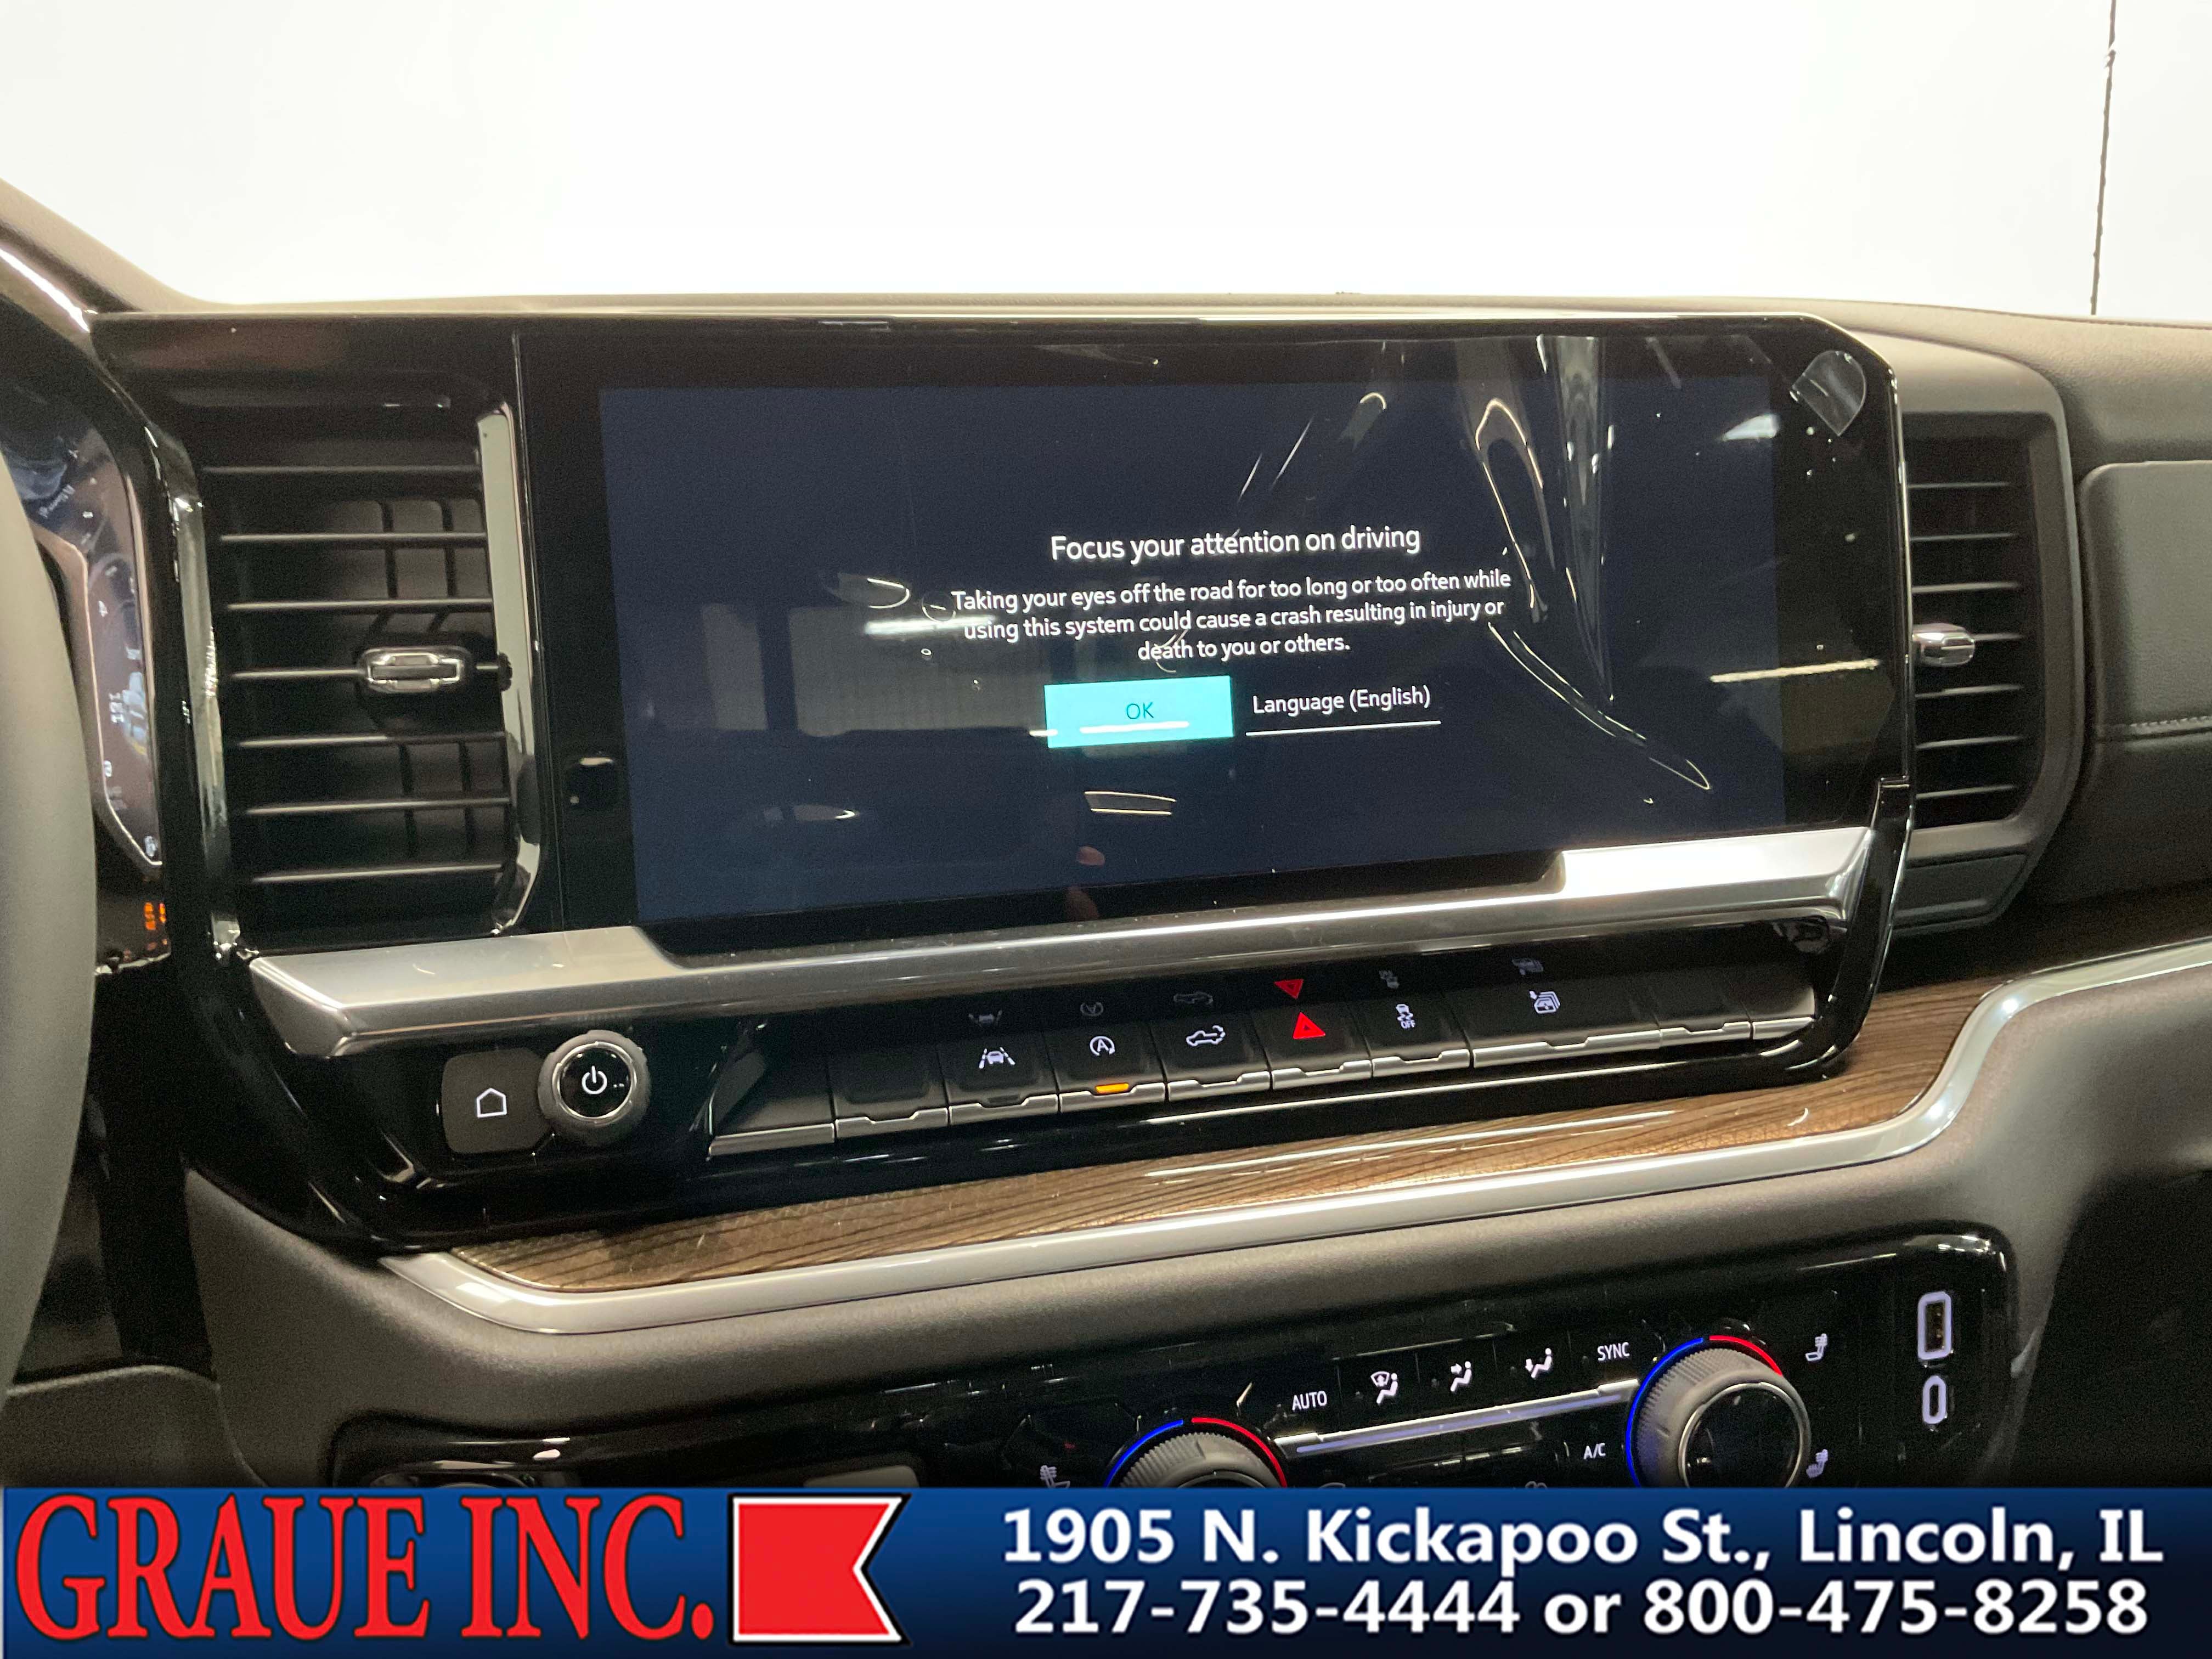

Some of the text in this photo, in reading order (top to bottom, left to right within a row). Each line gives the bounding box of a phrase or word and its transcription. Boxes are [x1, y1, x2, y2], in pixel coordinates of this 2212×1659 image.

[1051, 524, 1421, 566] Focus your attention on driving
[951, 567, 1512, 613] Taking your eyes off the road for too long or too often while
[963, 599, 1505, 644] using this system could cause a crash resulting in injury or
[1137, 632, 1351, 663] death to you or others.
[1126, 701, 1154, 720] OK
[1252, 684, 1431, 718] Language (English)
[1401, 1020, 1416, 1029] OFF
[1597, 1341, 1630, 1361] SYNC
[1291, 1390, 1328, 1411] AUTO
[1583, 1442, 1606, 1460] A/C
